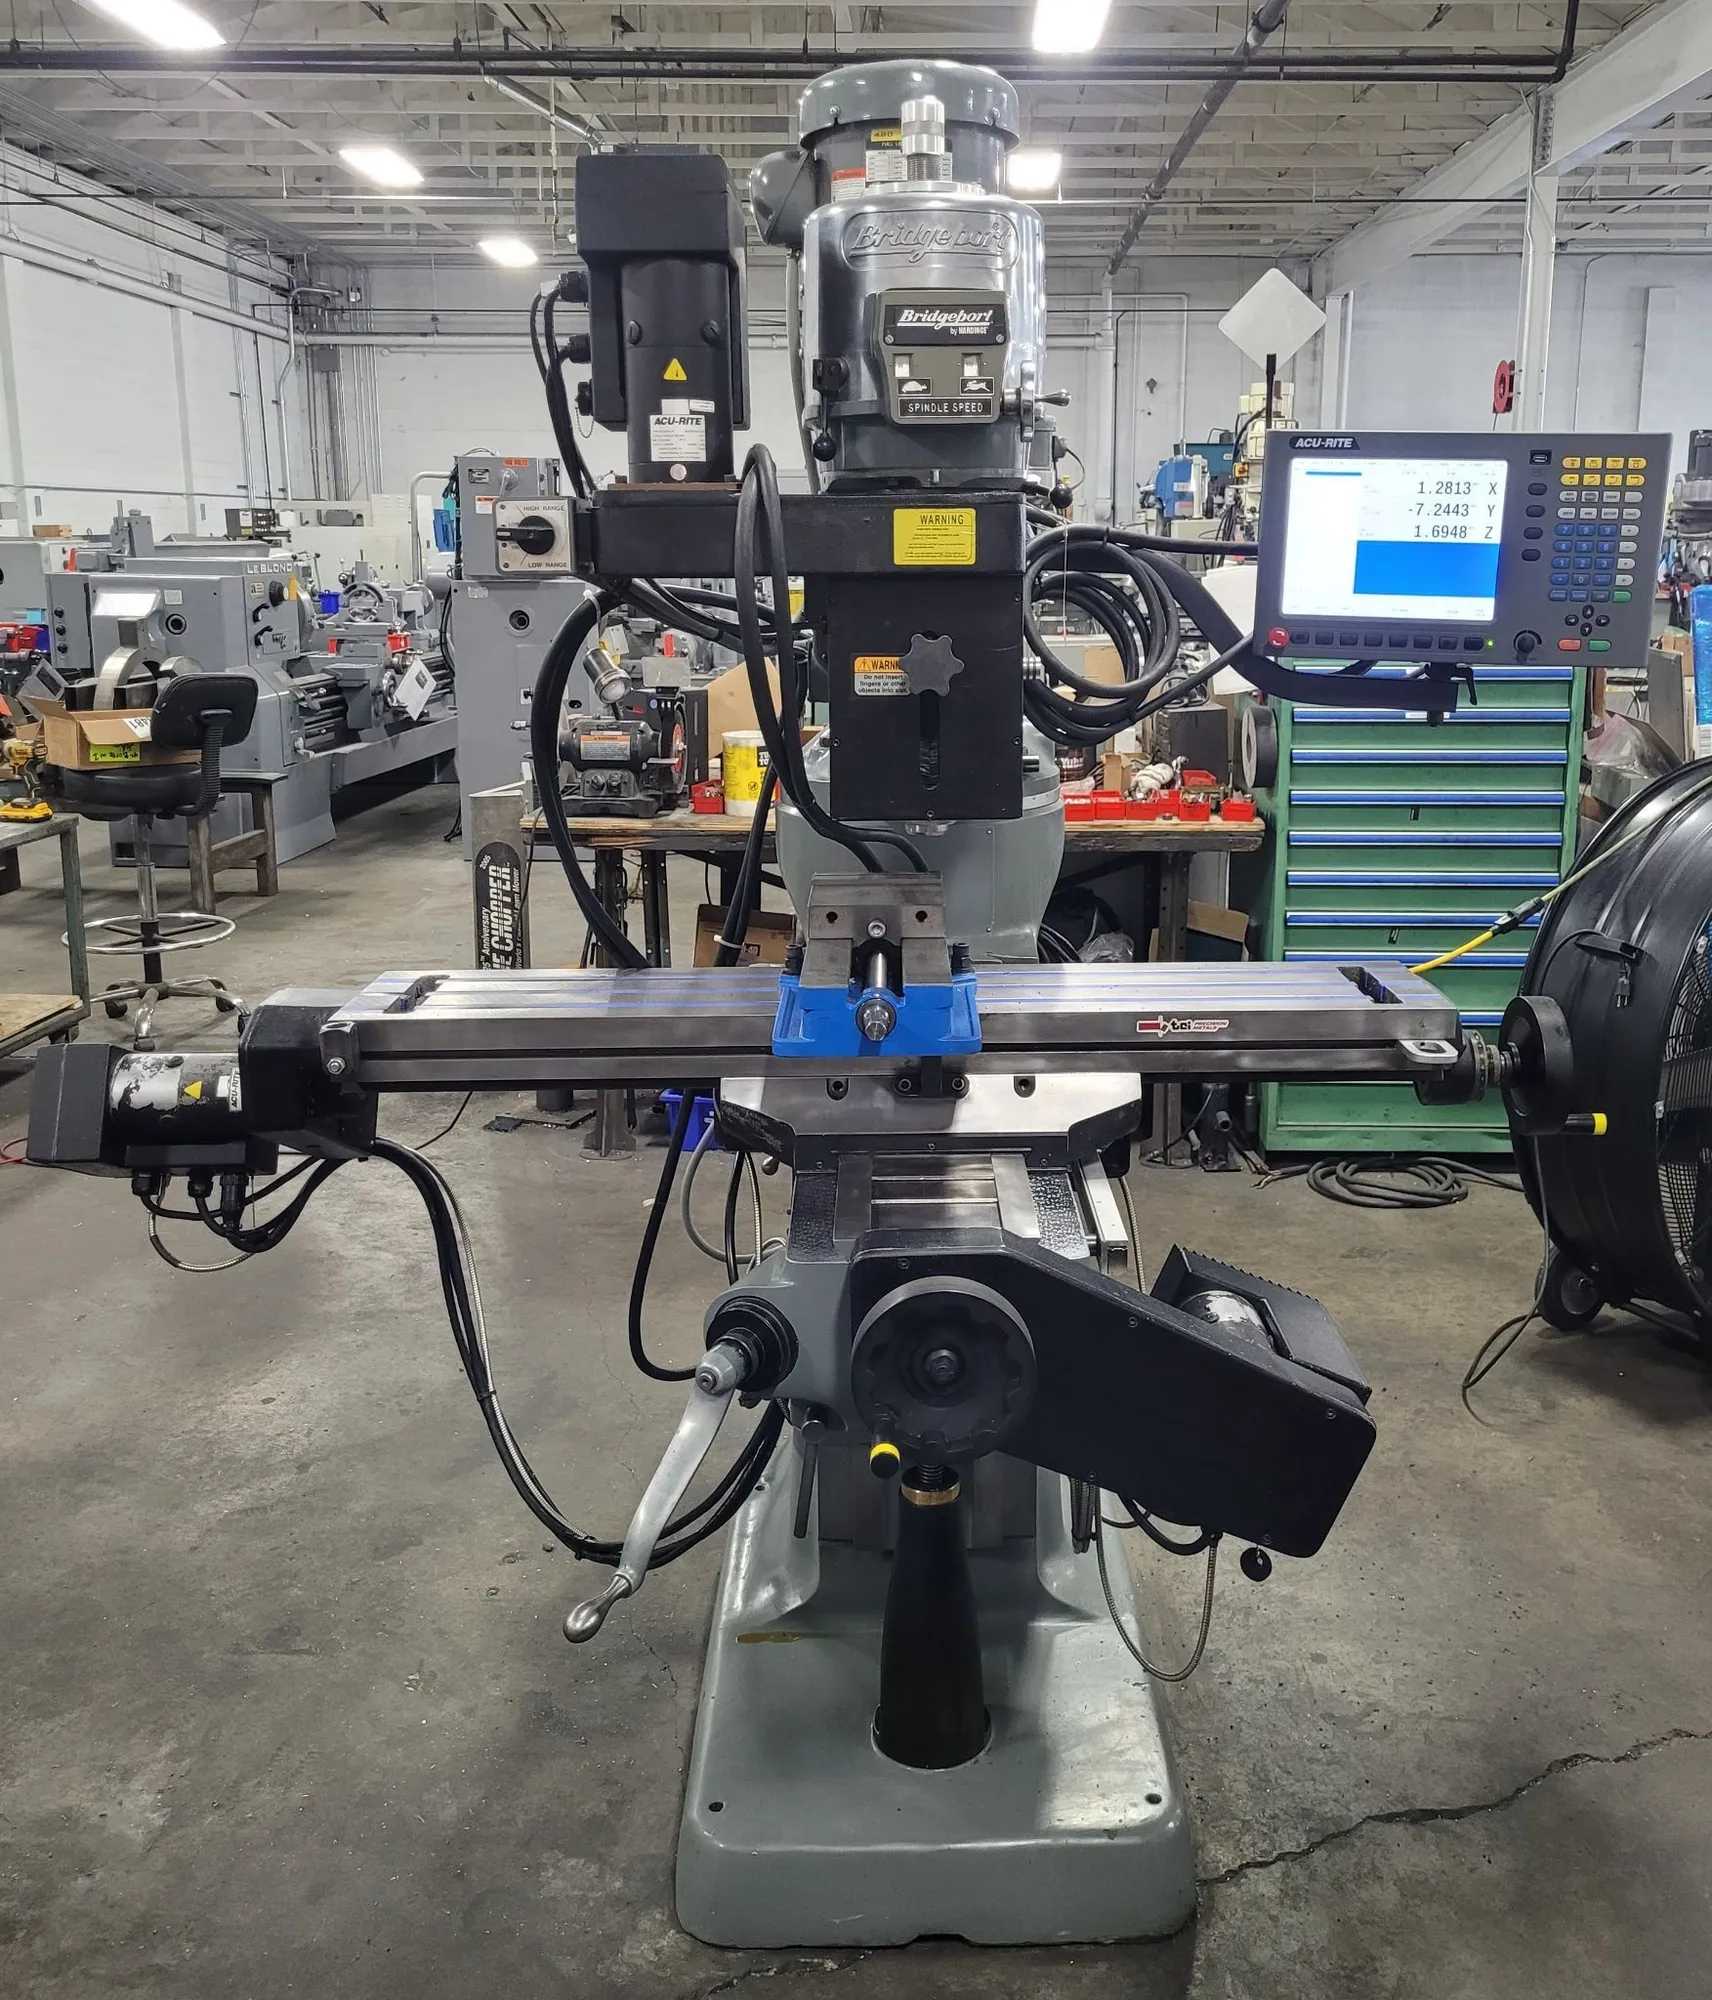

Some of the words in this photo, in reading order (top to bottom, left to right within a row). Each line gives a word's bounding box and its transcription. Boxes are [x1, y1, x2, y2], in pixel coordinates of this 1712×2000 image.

[851, 223, 1012, 264] Bridgeport
[898, 308, 994, 330] Bridgeport
[950, 327, 957, 336] by
[908, 402, 949, 413] SPINDLE
[952, 402, 984, 413] SPEED
[654, 417, 703, 426] ACU-RITE
[1295, 437, 1354, 448] ACU-RITE
[1417, 481, 1471, 495] 1.2813
[1488, 481, 1498, 496] X
[523, 504, 540, 512] HIGH
[1408, 503, 1469, 517] -7.2443
[1487, 504, 1496, 518] Y
[919, 514, 964, 525] WARNING
[1413, 525, 1467, 539] 1.6948
[1484, 526, 1493, 539] Z
[527, 561, 542, 569] LOW
[488, 865, 513, 952] CHOPPER
[481, 905, 492, 956] Anniversary
[1170, 1020, 1191, 1030] tci
